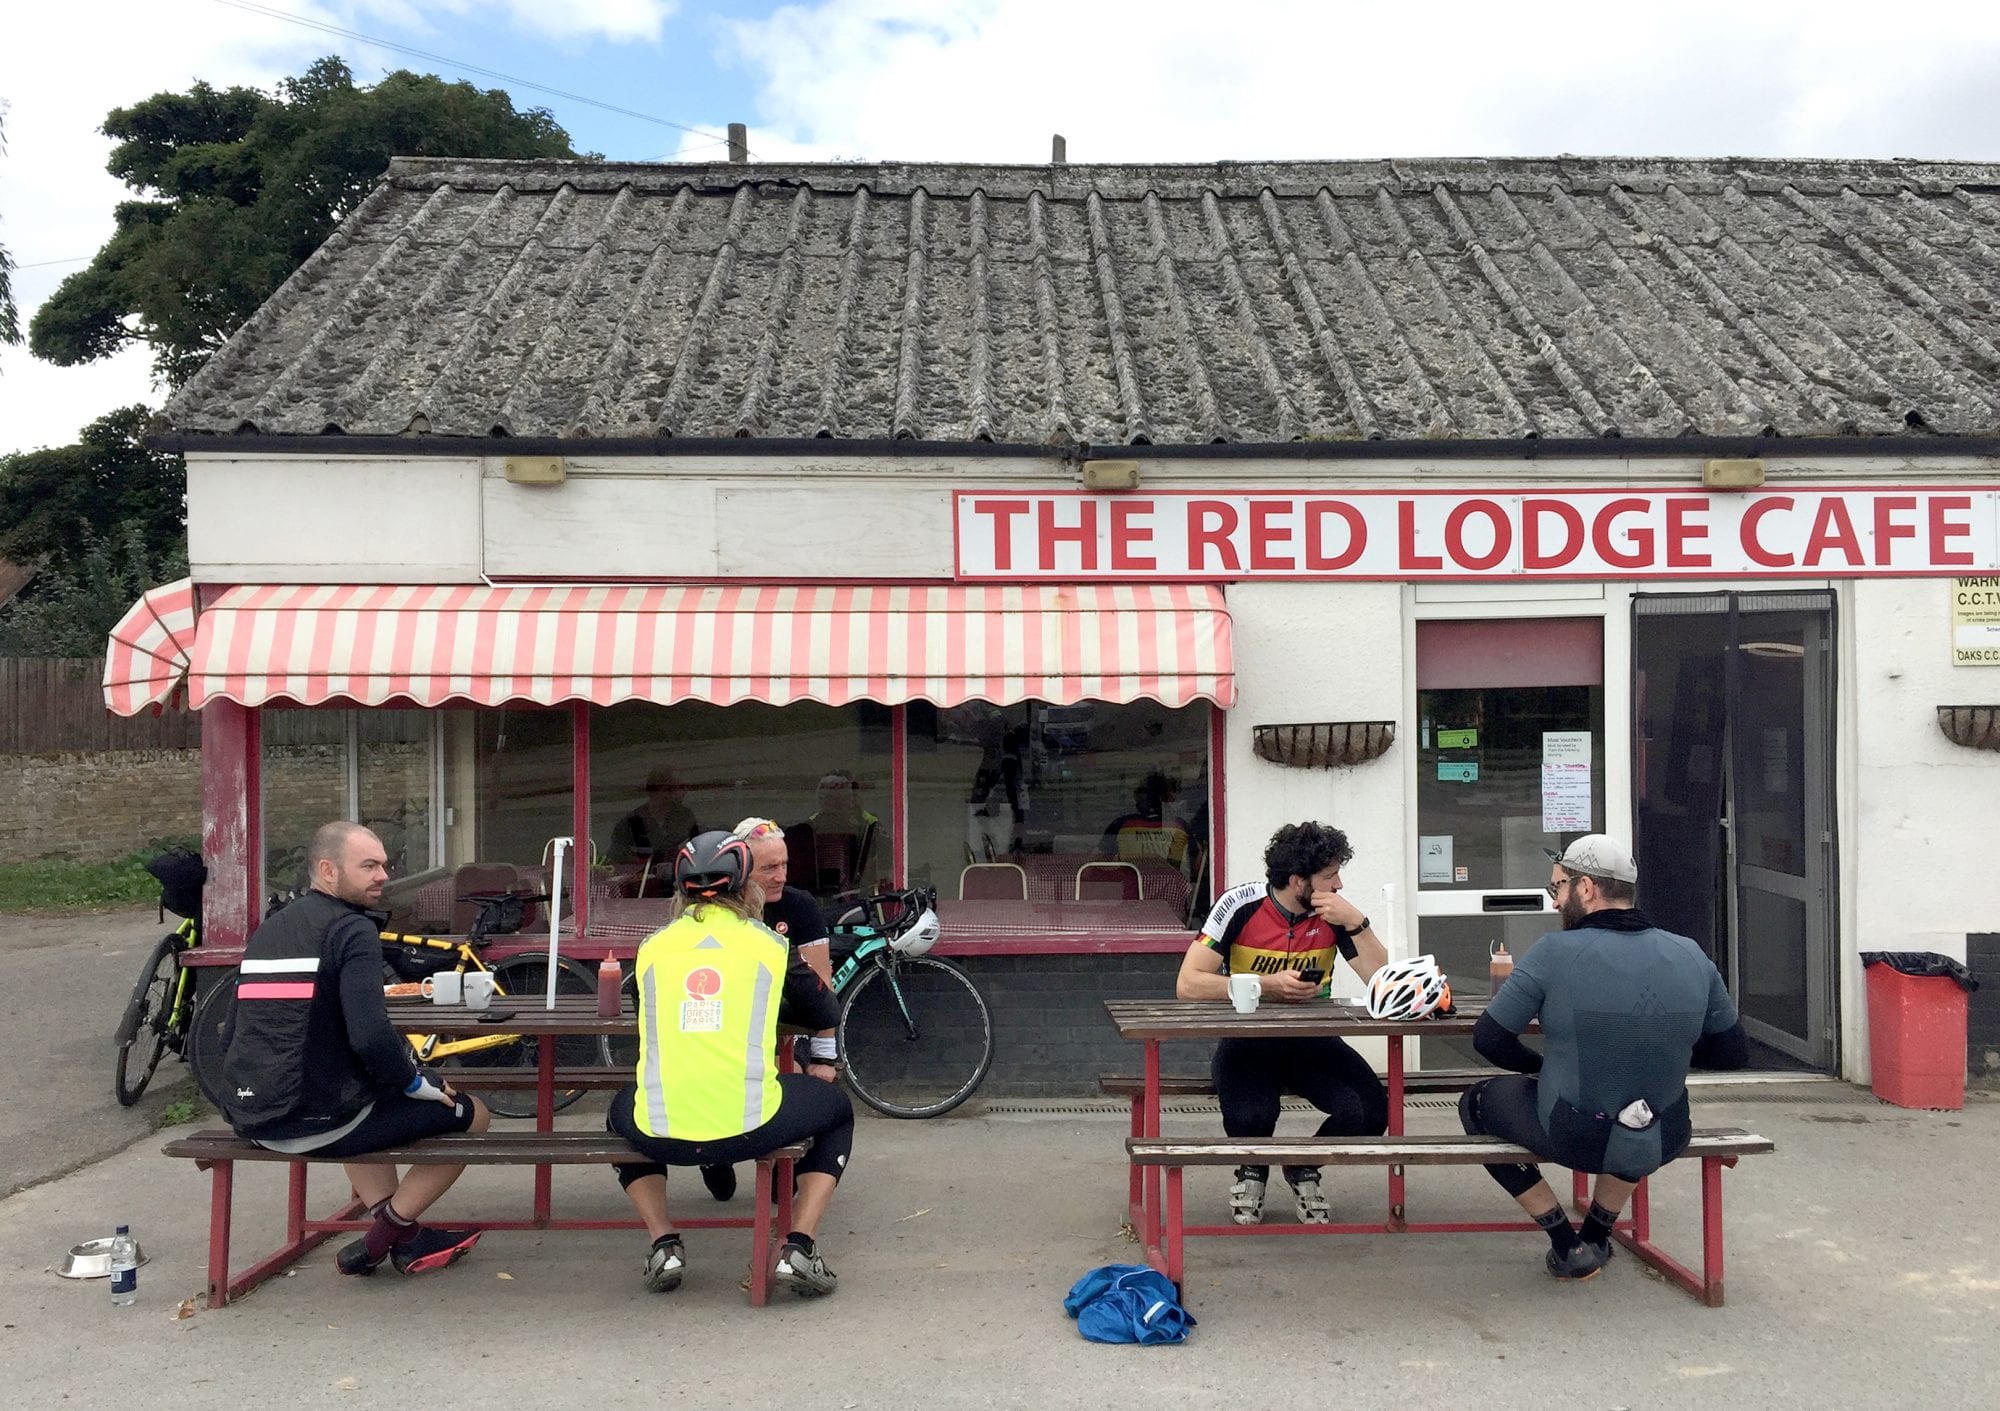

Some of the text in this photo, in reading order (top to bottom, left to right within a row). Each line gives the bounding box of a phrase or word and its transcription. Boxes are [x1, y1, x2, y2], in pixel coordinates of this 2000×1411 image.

[975, 496, 1975, 571] THE RED LODGE CAFE
[1957, 651, 1982, 660] OAKS
[1250, 955, 1321, 974] BRIXTON
[687, 1009, 715, 1017] BREST
